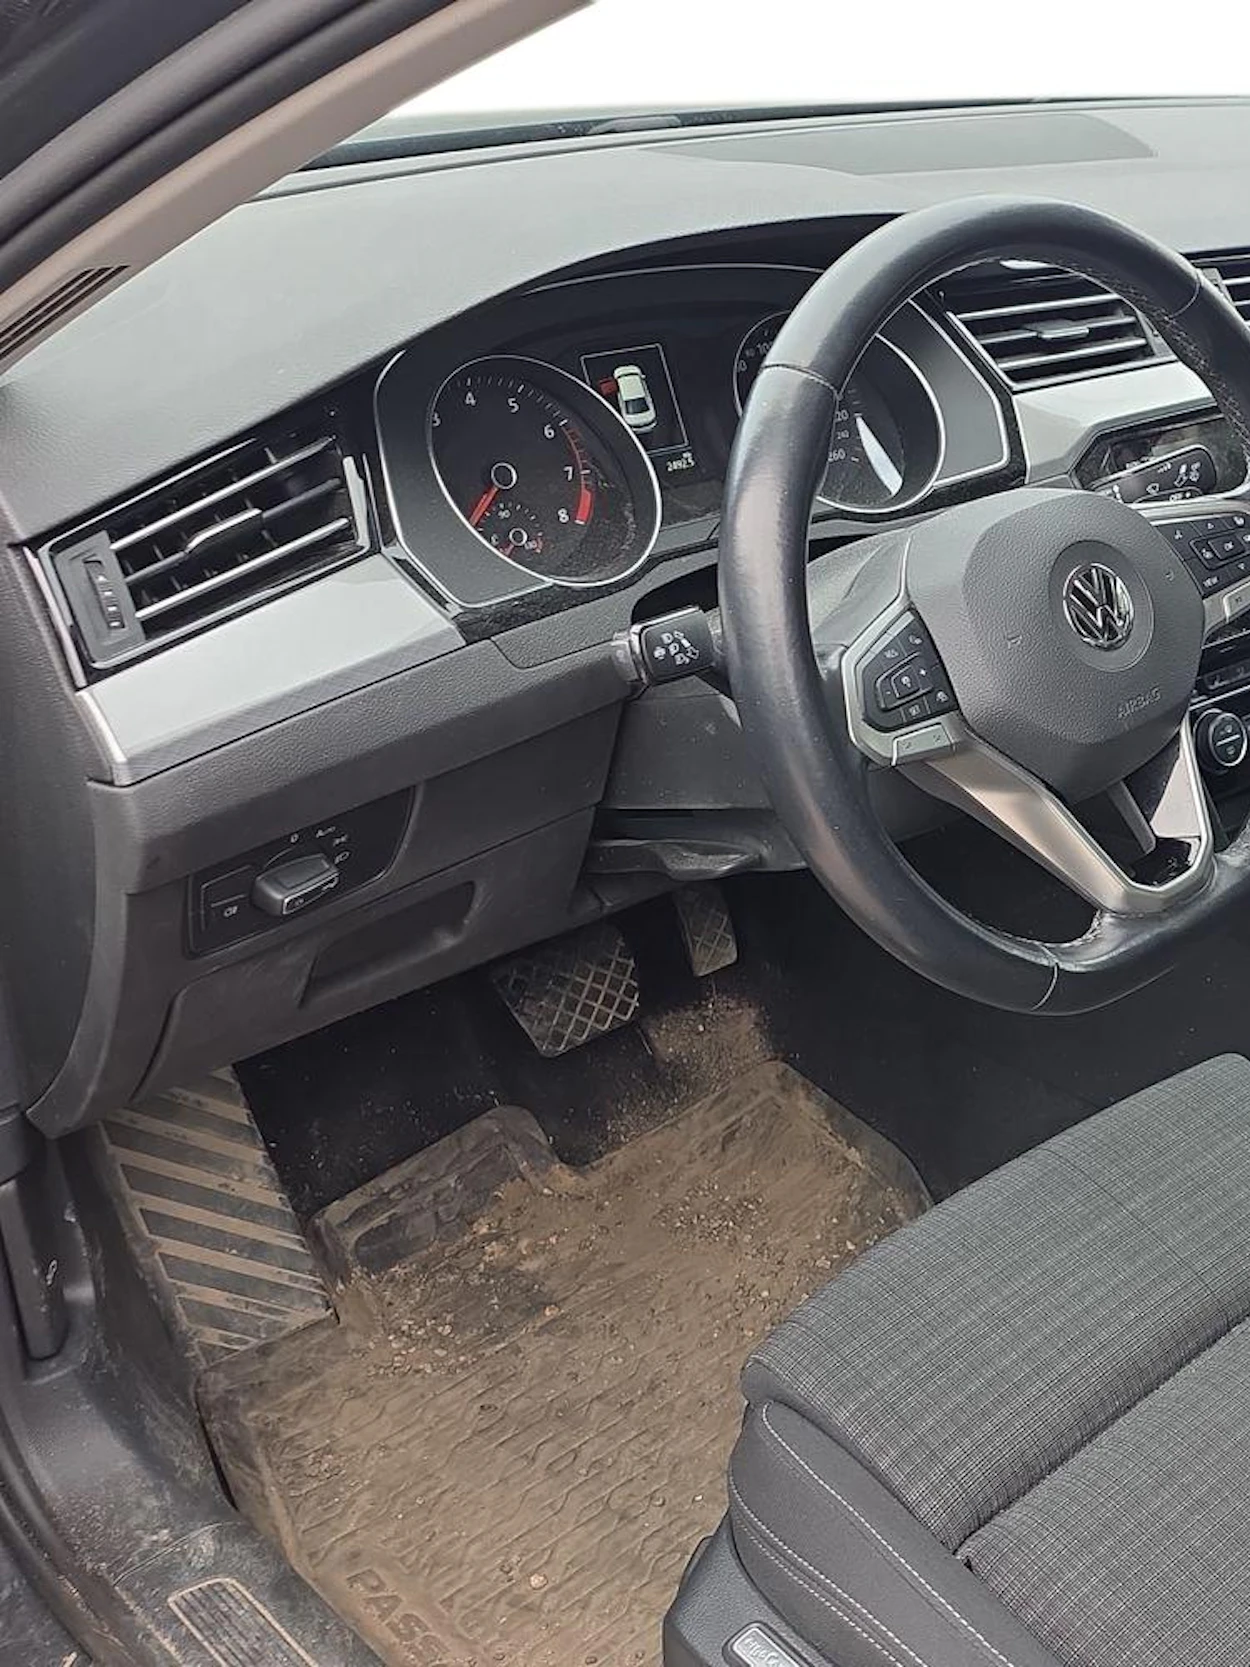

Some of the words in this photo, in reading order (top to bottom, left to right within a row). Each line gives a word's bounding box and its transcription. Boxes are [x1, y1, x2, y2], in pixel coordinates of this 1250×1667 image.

[464, 391, 476, 407] 4
[507, 397, 520, 413] 5
[543, 424, 556, 439] 6
[563, 465, 574, 482] 7
[557, 507, 570, 524] 8
